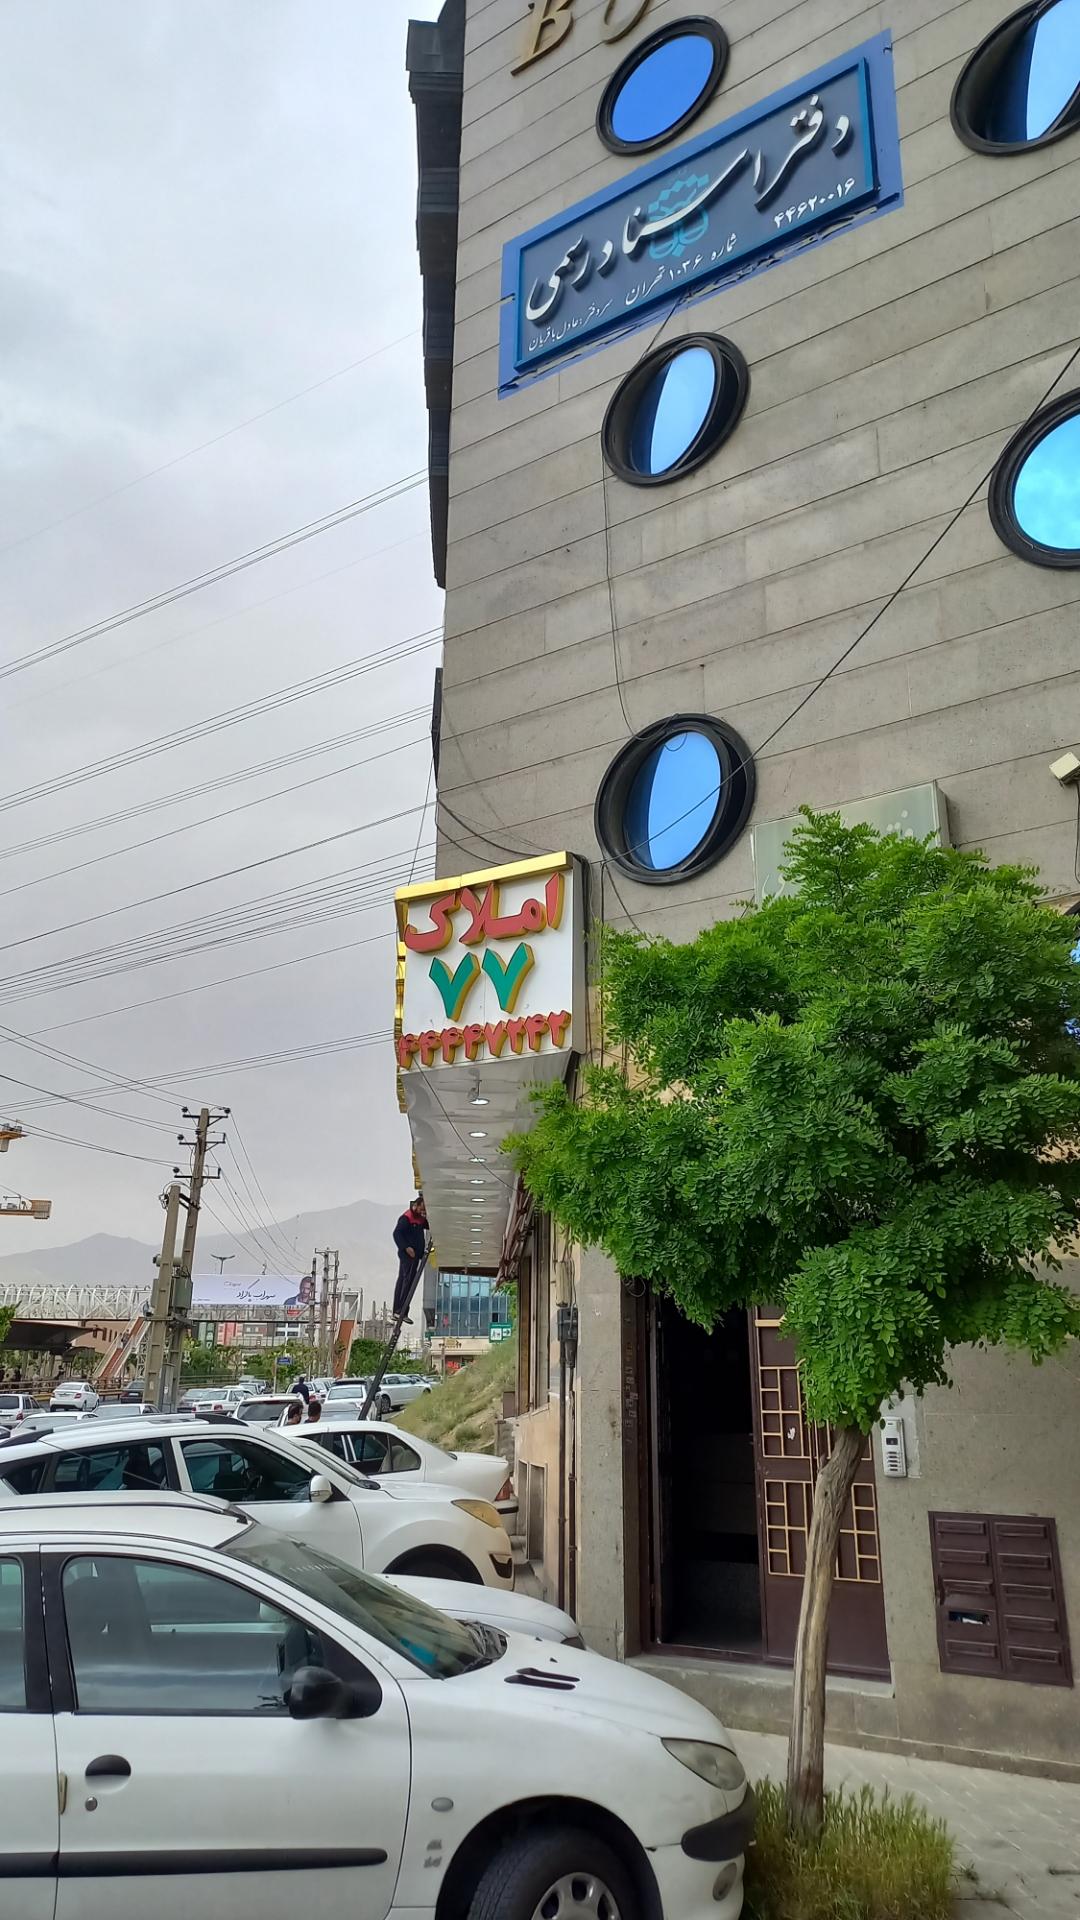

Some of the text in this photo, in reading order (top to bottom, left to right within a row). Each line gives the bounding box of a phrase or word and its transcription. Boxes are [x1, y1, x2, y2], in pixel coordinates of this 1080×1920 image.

[526, 93, 850, 322] دفتر اسناد رسمی
[711, 231, 738, 262] شماره
[625, 265, 666, 306] تهران
[403, 871, 566, 954] املاک
[428, 942, 536, 1023] ۷۷
